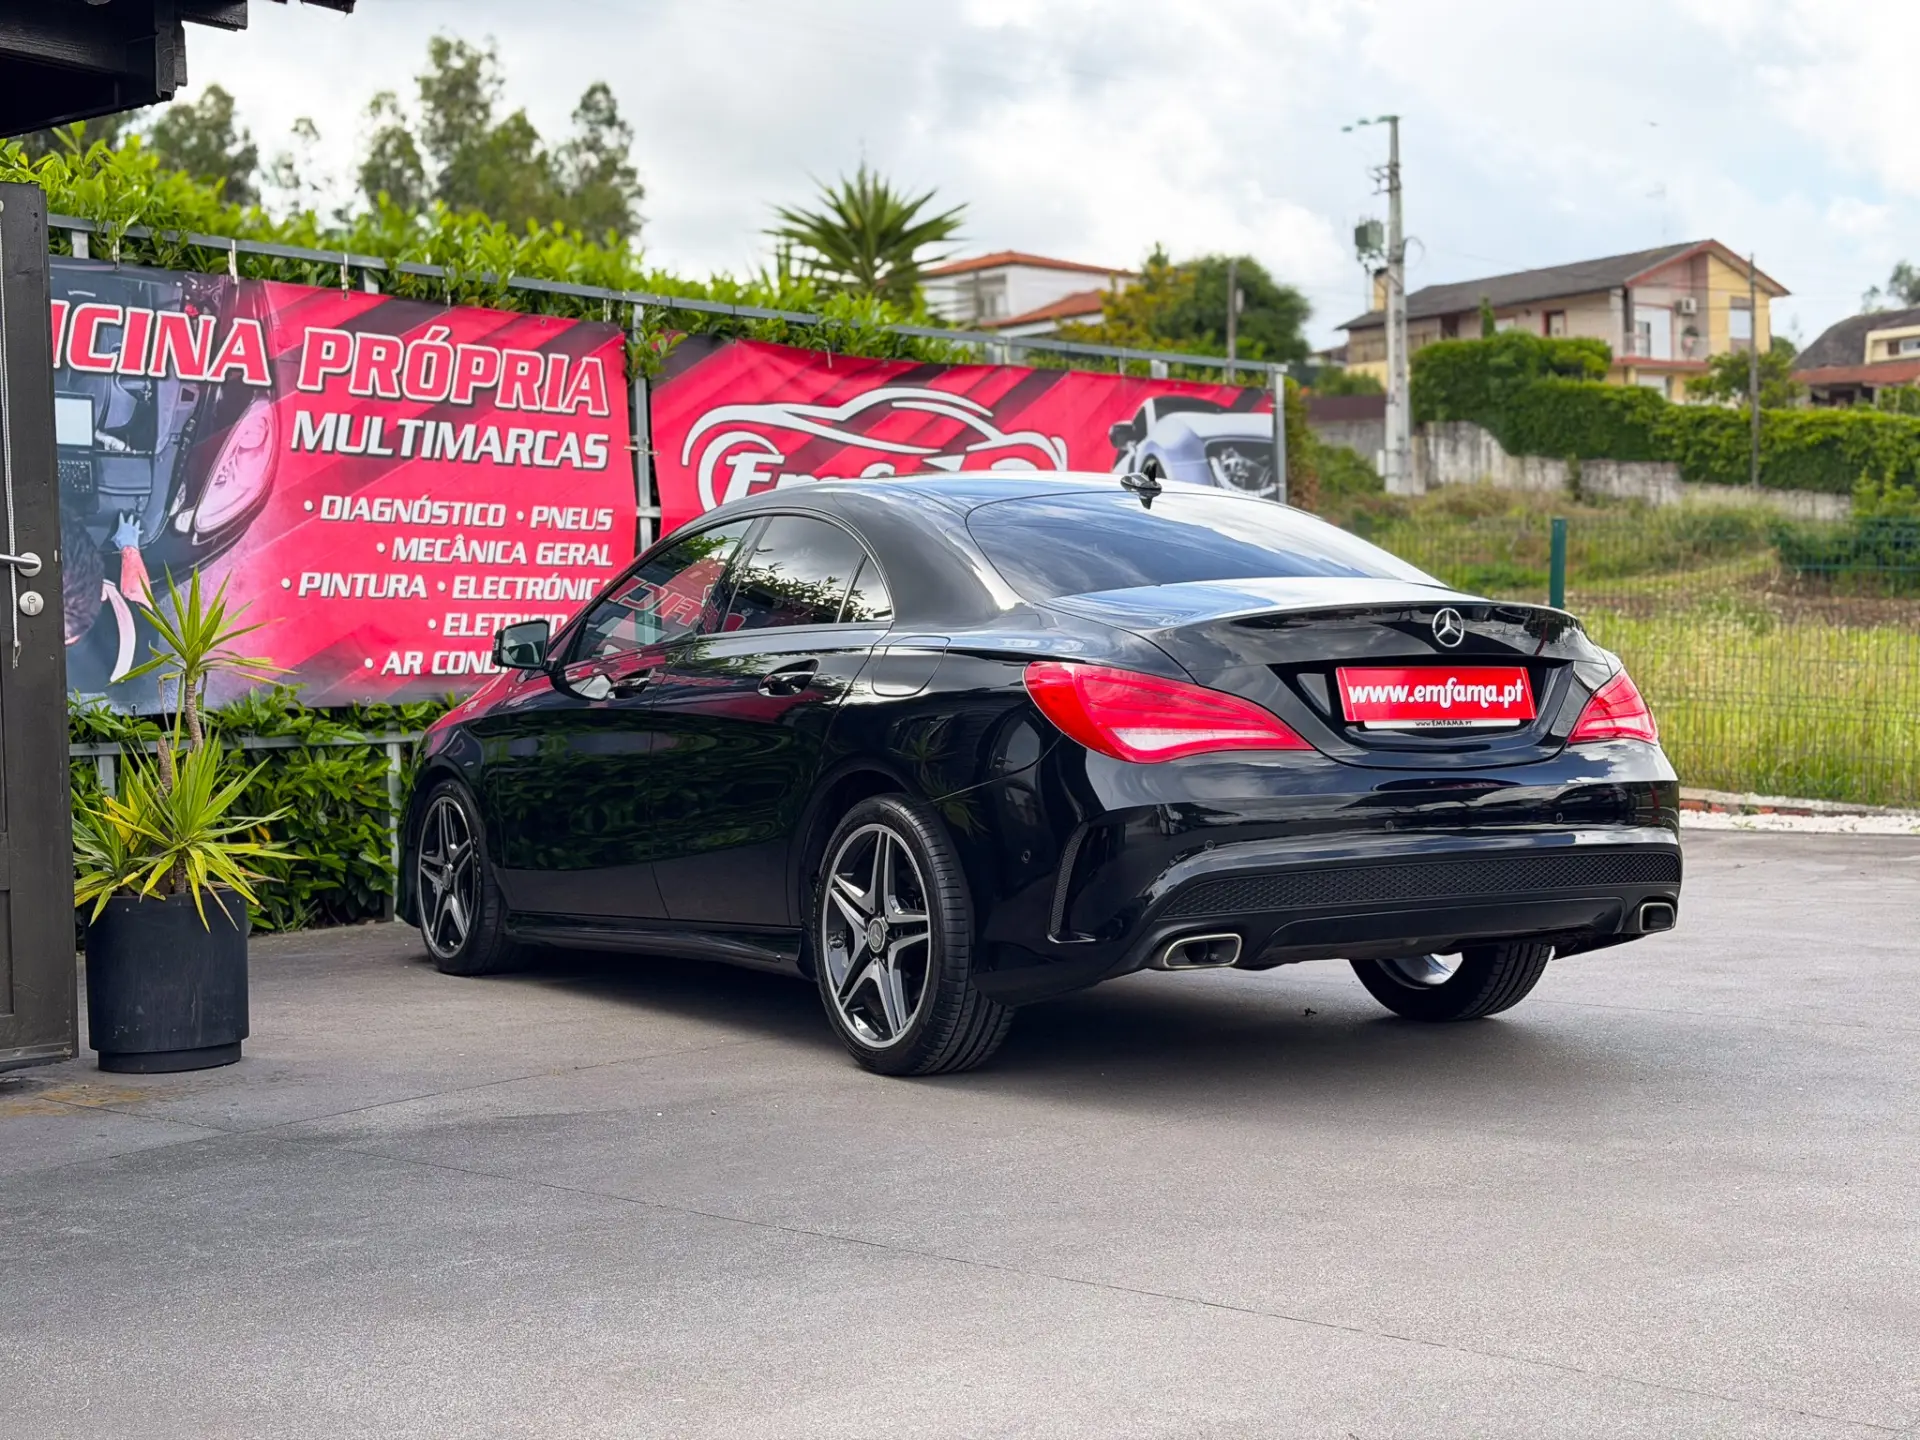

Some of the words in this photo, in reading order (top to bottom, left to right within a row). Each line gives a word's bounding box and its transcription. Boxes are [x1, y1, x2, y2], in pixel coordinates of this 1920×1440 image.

[297, 324, 609, 416] PRÓPRIA
[291, 410, 609, 470] MULTIMARCAS
[320, 494, 507, 527] DIAGNÓSTICO
[530, 506, 613, 531] PNEUS
[392, 534, 527, 564] MECÂNICA
[535, 542, 613, 566] GERAL
[298, 571, 427, 597] PINTURA
[451, 572, 606, 600] ELECTRÓNIC
[381, 651, 424, 675] AR
[431, 650, 512, 676] COND
[1349, 677, 1524, 708] www.emfama.pt
